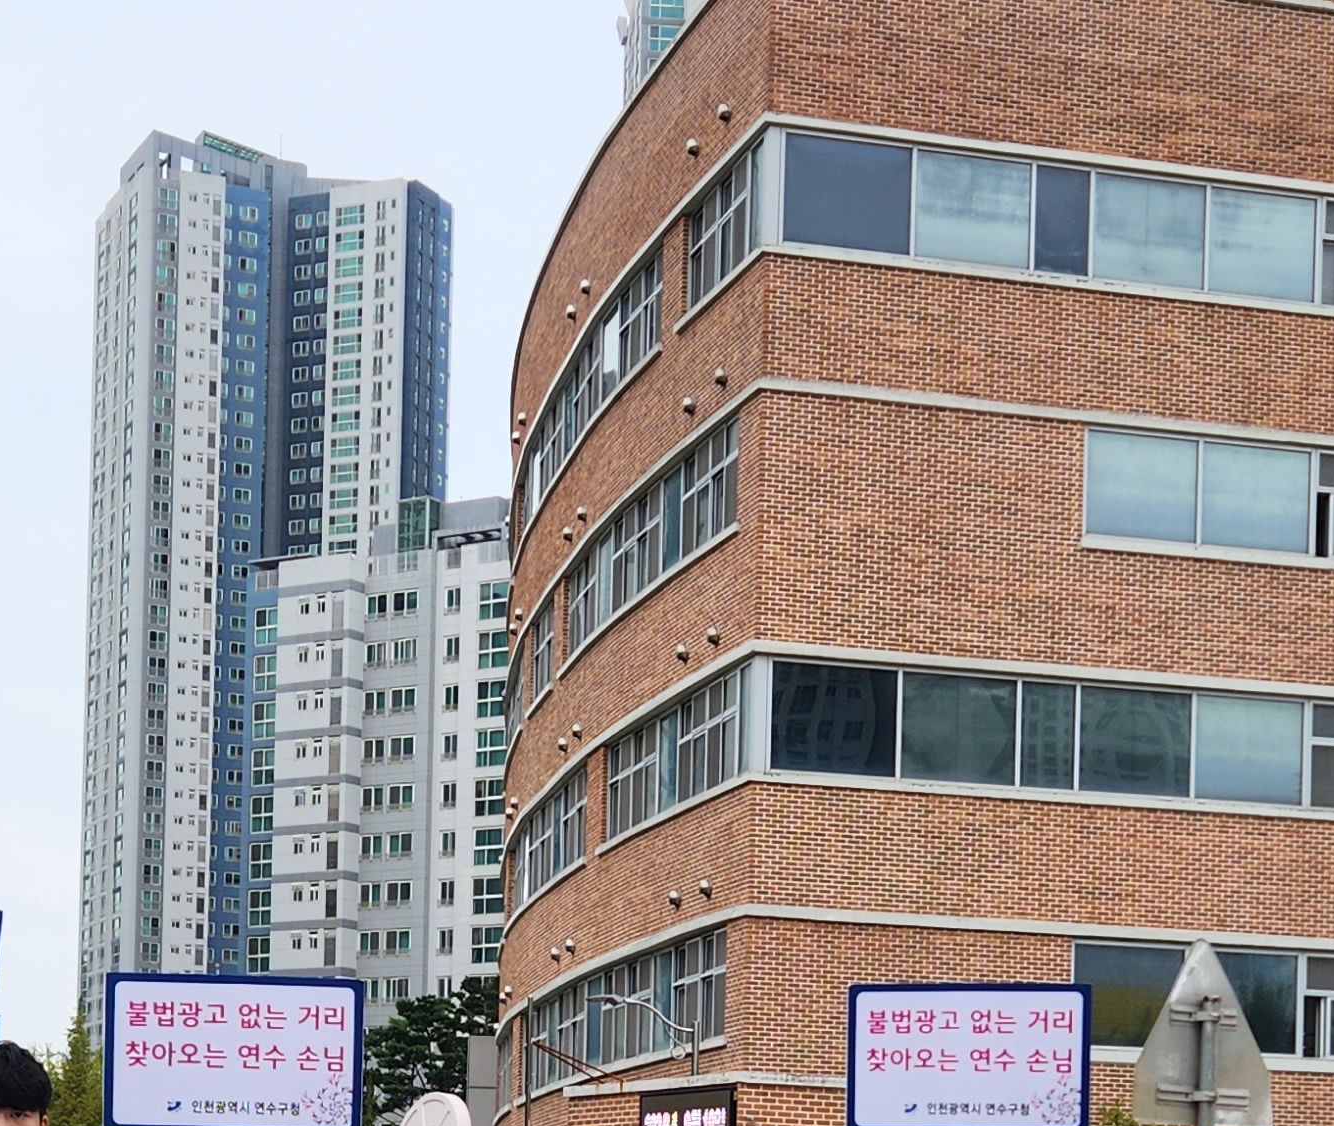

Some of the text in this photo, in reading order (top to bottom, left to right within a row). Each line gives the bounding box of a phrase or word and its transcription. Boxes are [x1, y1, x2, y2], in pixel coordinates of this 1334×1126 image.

[126, 1001, 345, 1031] 불법광고 없는 거리
[867, 1010, 1073, 1034] 불법광고 없는 거리
[125, 1041, 344, 1073] 찾아오는 연수 손님
[867, 1048, 1072, 1074] 찾아오는 연수 손님
[191, 1100, 301, 1116] 인천광역시 연수구청
[927, 1103, 1030, 1116] 인천광역시 연수구청
